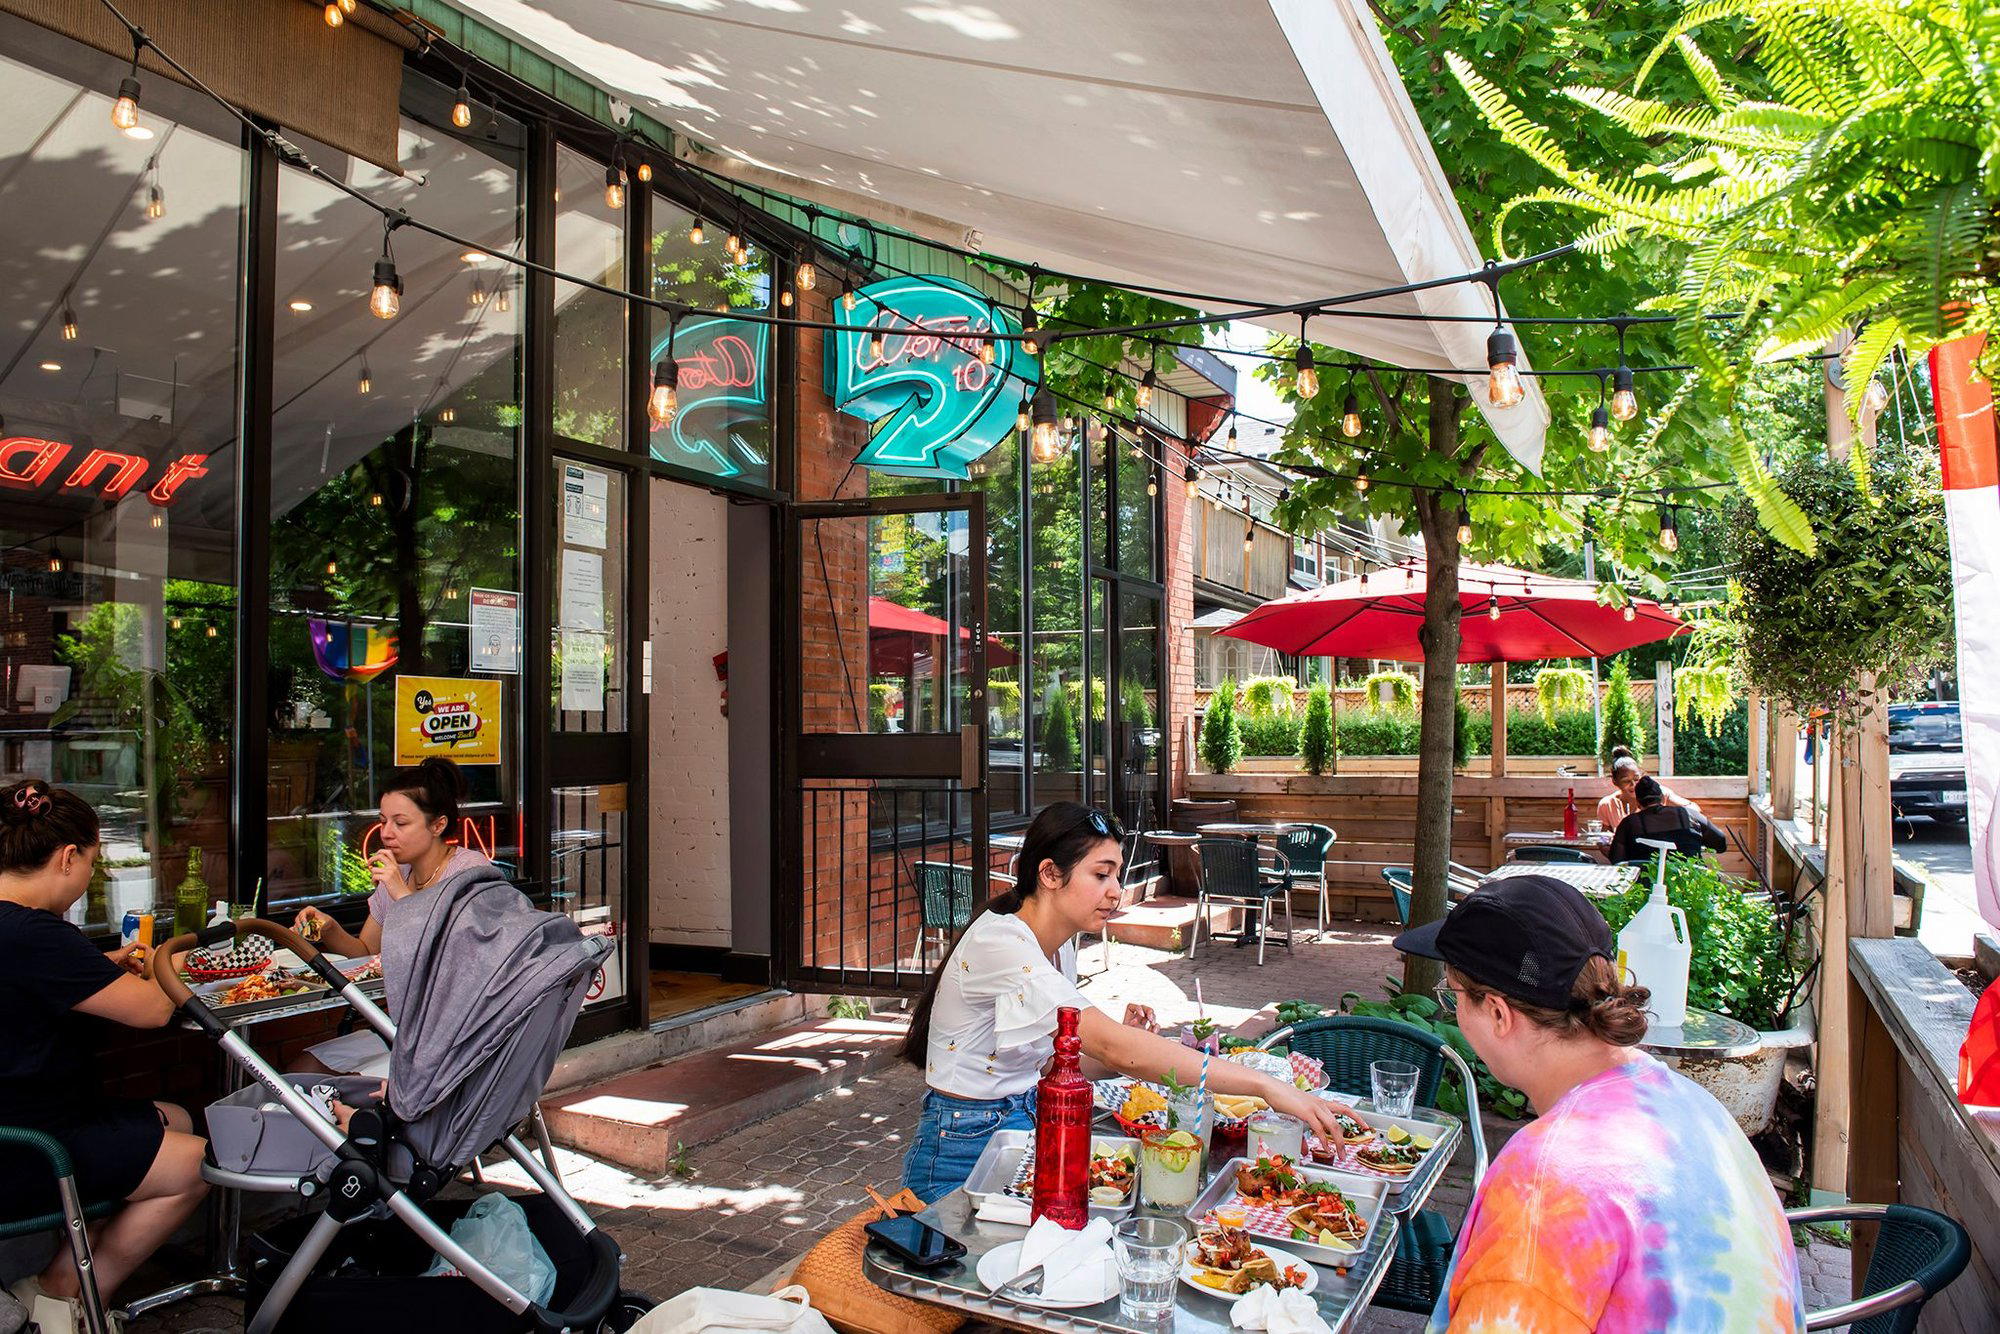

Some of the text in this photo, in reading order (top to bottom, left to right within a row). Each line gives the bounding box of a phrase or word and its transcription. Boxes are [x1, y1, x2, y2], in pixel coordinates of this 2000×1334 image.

[952, 359, 987, 392] 10
[417, 696, 432, 709] Yes
[437, 704, 465, 713] WE ARE
[429, 713, 470, 731] OPEN
